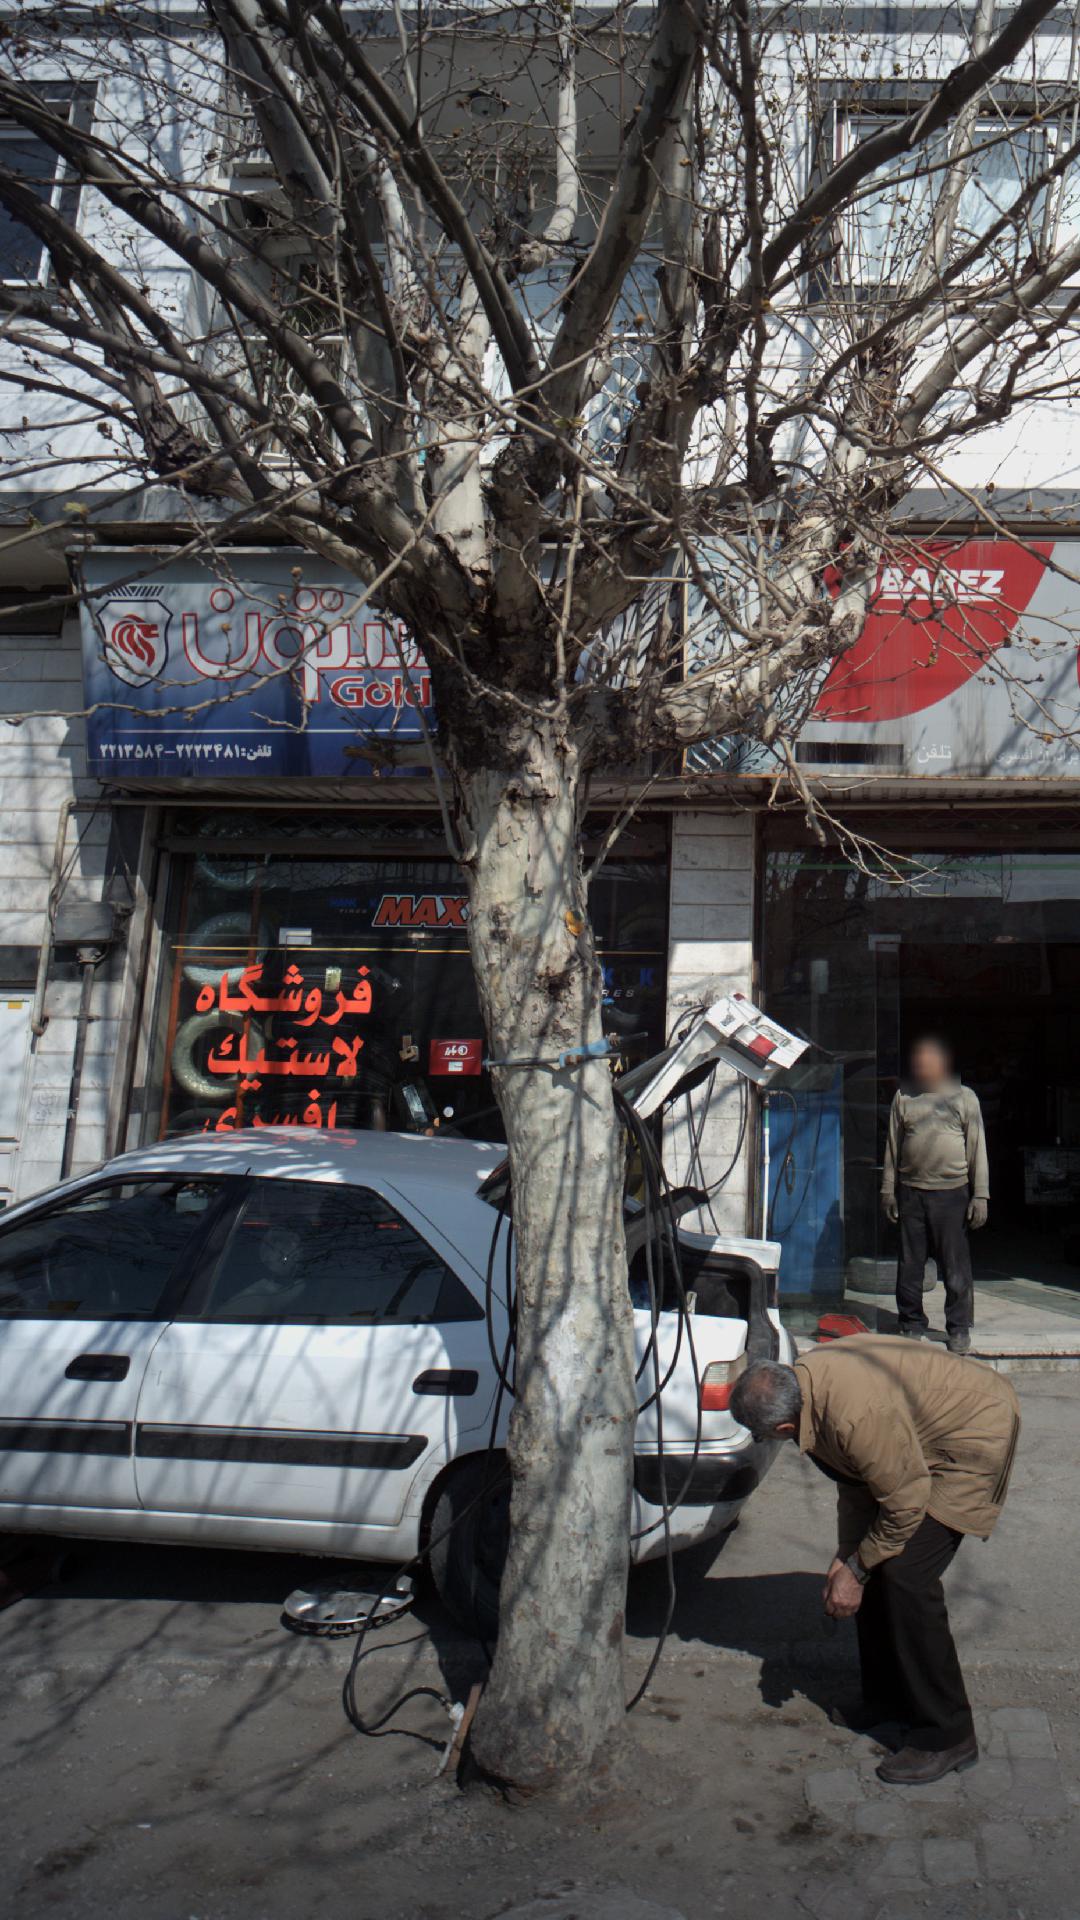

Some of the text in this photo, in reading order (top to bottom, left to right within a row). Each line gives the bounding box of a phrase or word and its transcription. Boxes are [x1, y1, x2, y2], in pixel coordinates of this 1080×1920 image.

[880, 567, 1005, 594] BAREZ
[330, 675, 433, 708] Gold
[372, 895, 469, 928] MAX
[195, 963, 373, 1026] فروشگاه
